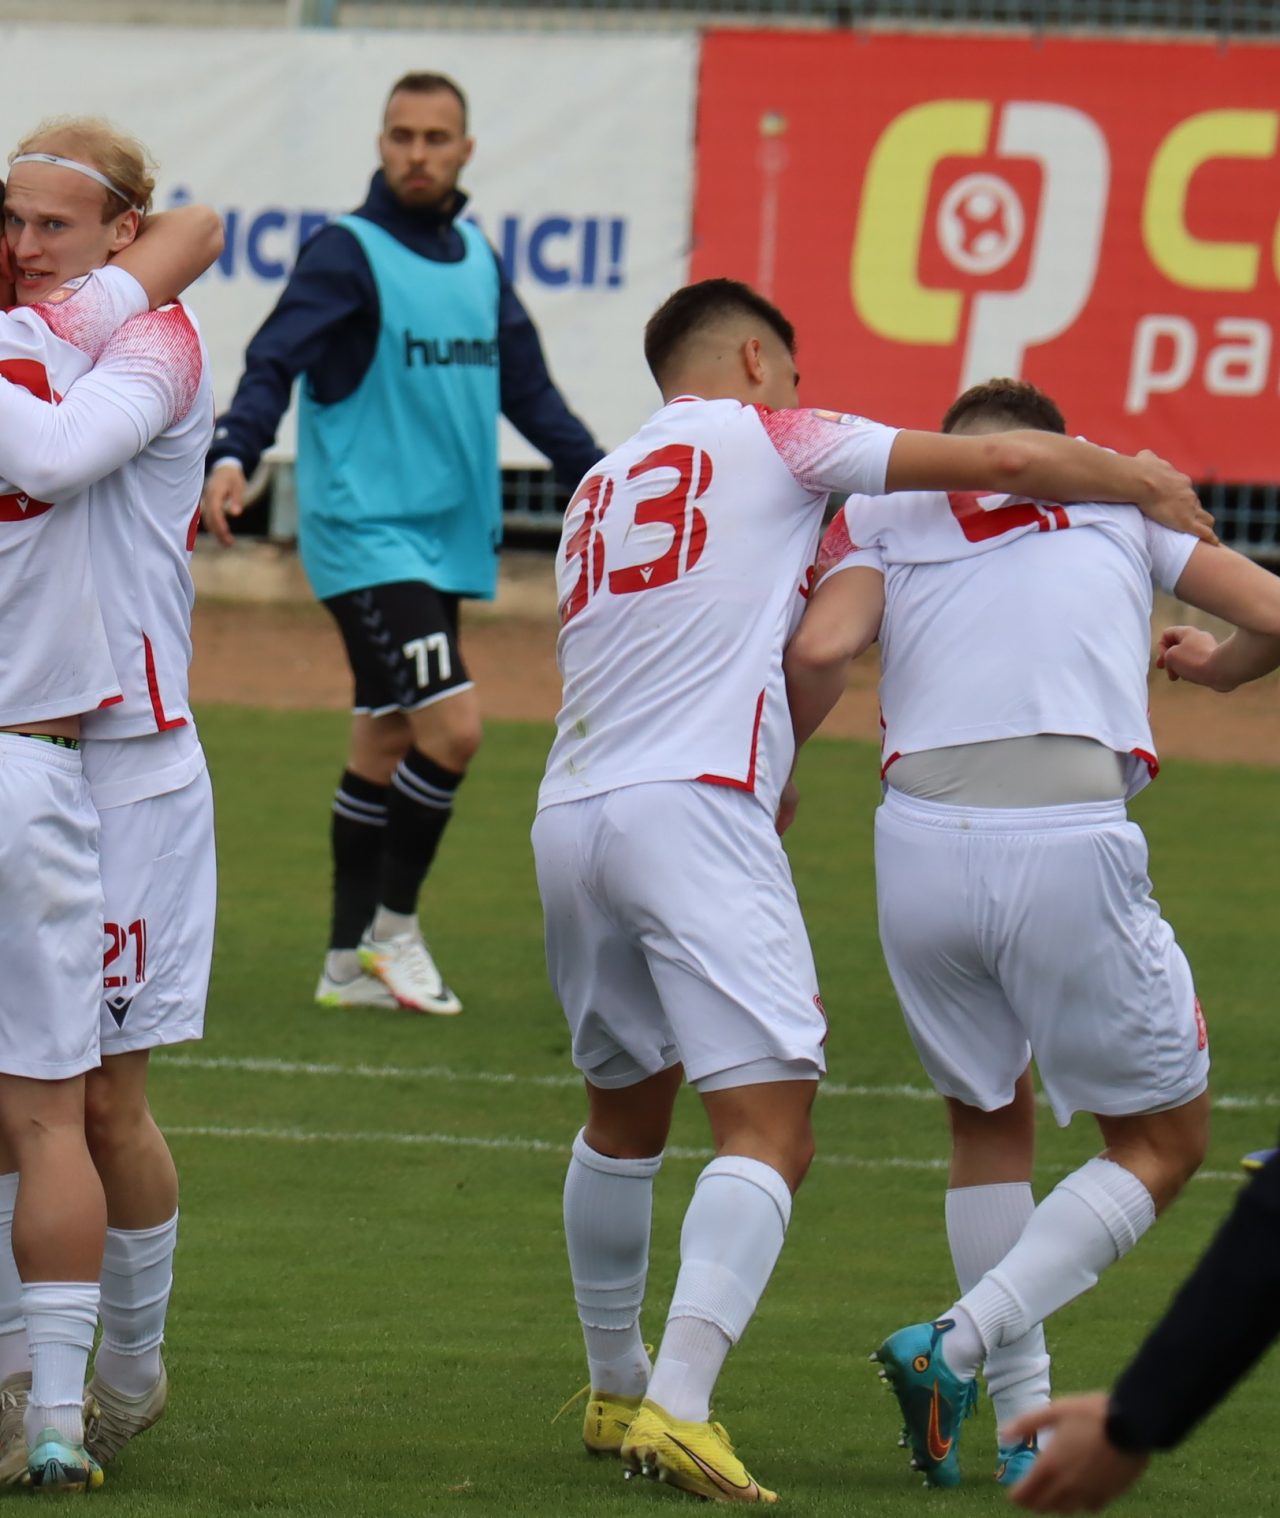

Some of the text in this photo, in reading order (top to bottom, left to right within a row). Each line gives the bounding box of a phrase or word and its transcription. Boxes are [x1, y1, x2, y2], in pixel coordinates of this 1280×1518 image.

[468, 217, 624, 289] ICI!
[1124, 312, 1280, 415] pa
[403, 631, 452, 688] 77
[103, 918, 147, 988] 21
